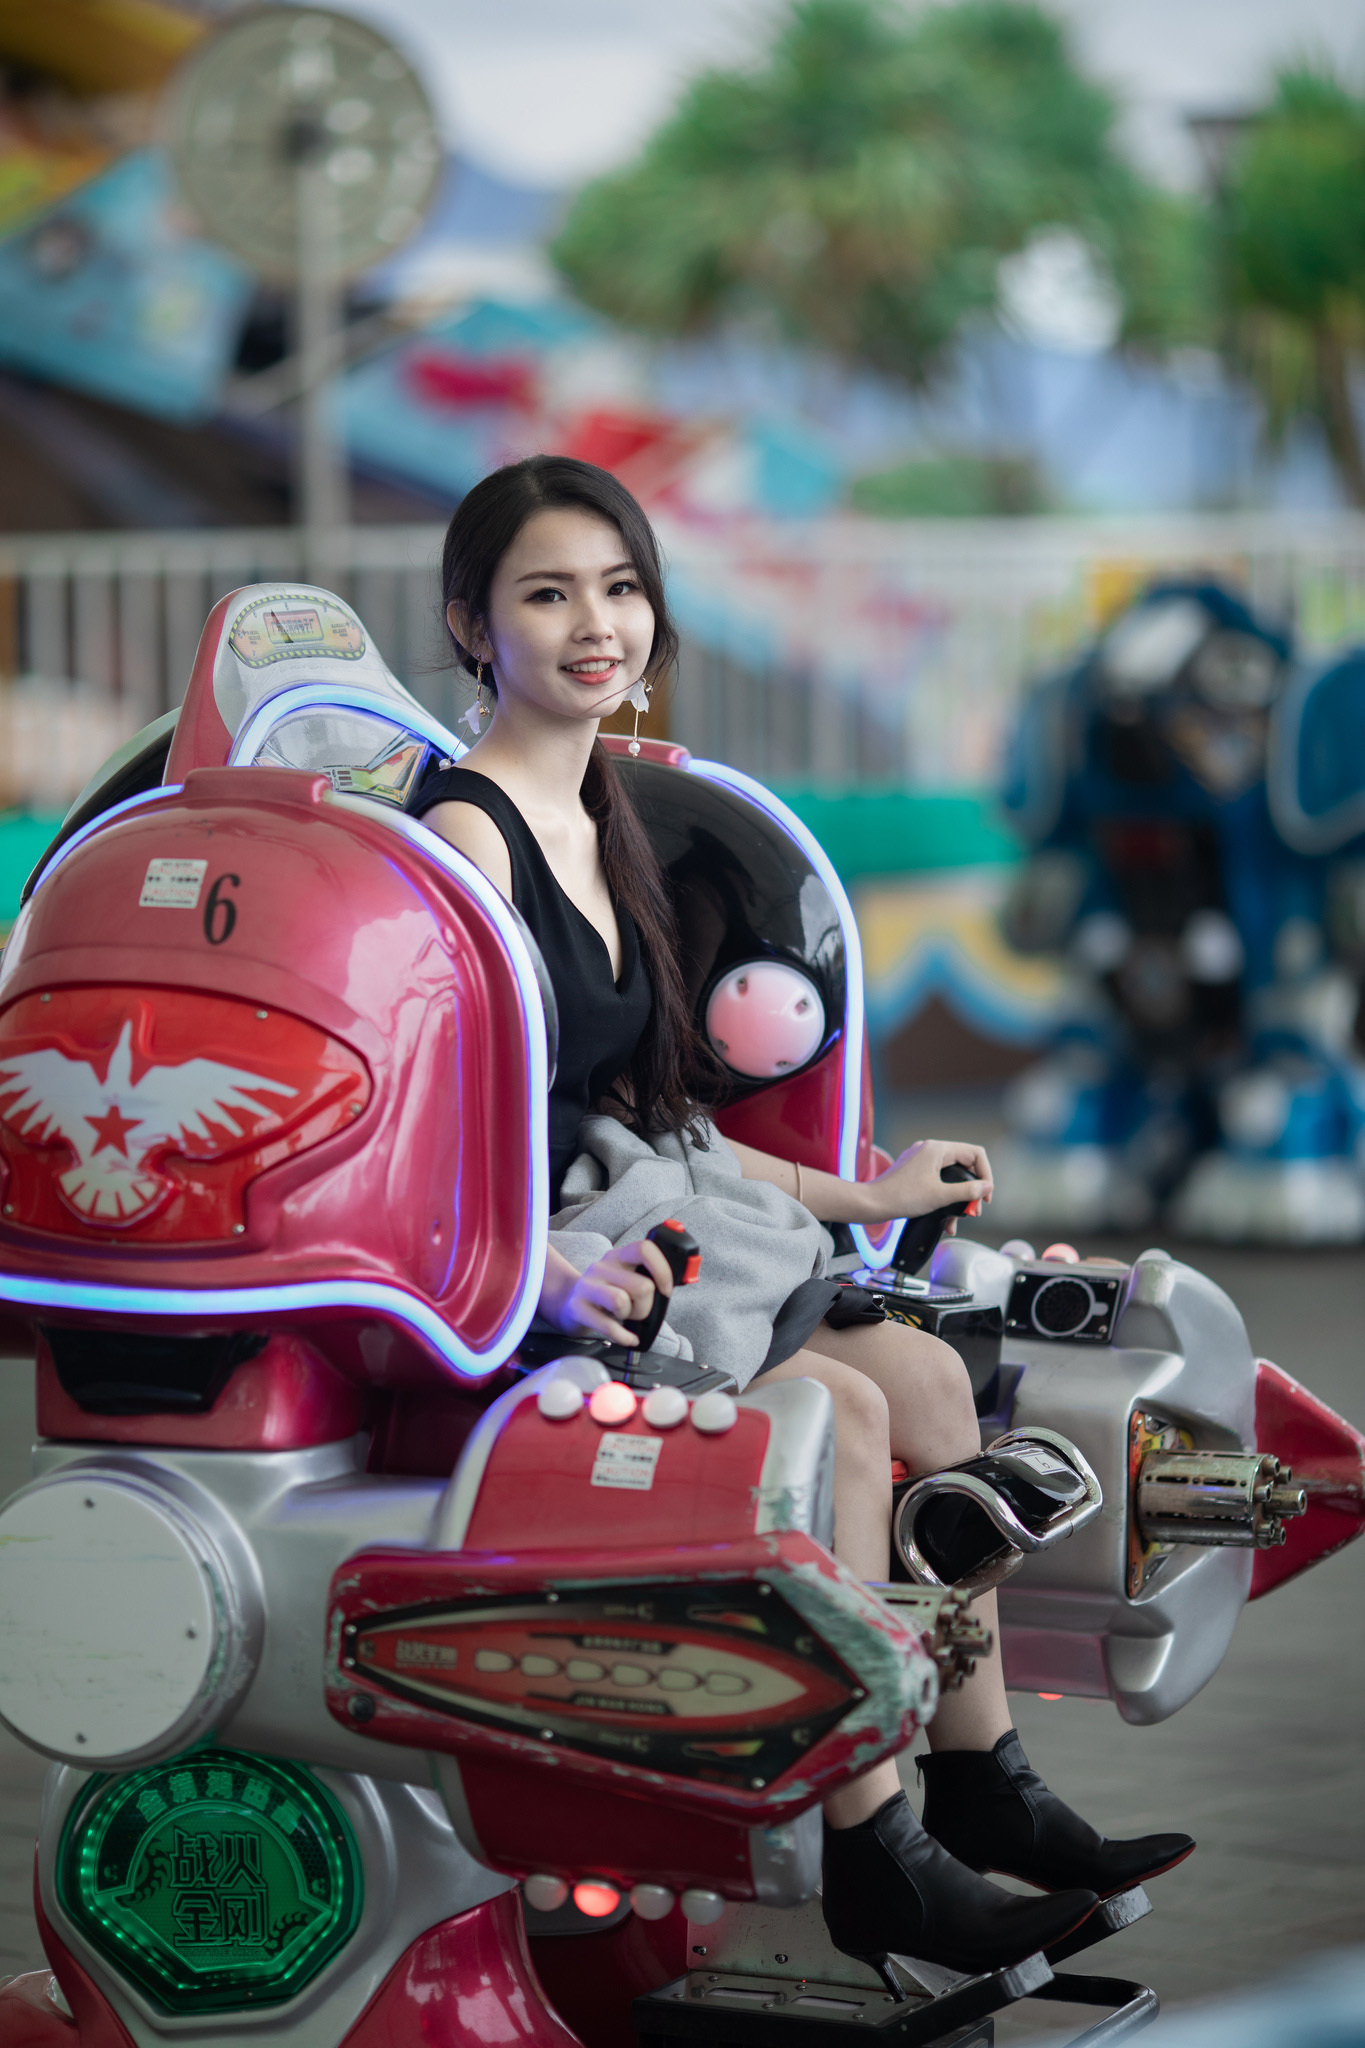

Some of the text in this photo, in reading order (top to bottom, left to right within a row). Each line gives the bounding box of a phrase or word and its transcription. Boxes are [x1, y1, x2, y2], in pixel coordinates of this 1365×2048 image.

[143, 887, 195, 898] CAUTION
[148, 865, 202, 876] CAUTION
[204, 873, 241, 946] 6
[169, 1825, 266, 1889] 战火
[172, 1888, 269, 1947] 金刚
